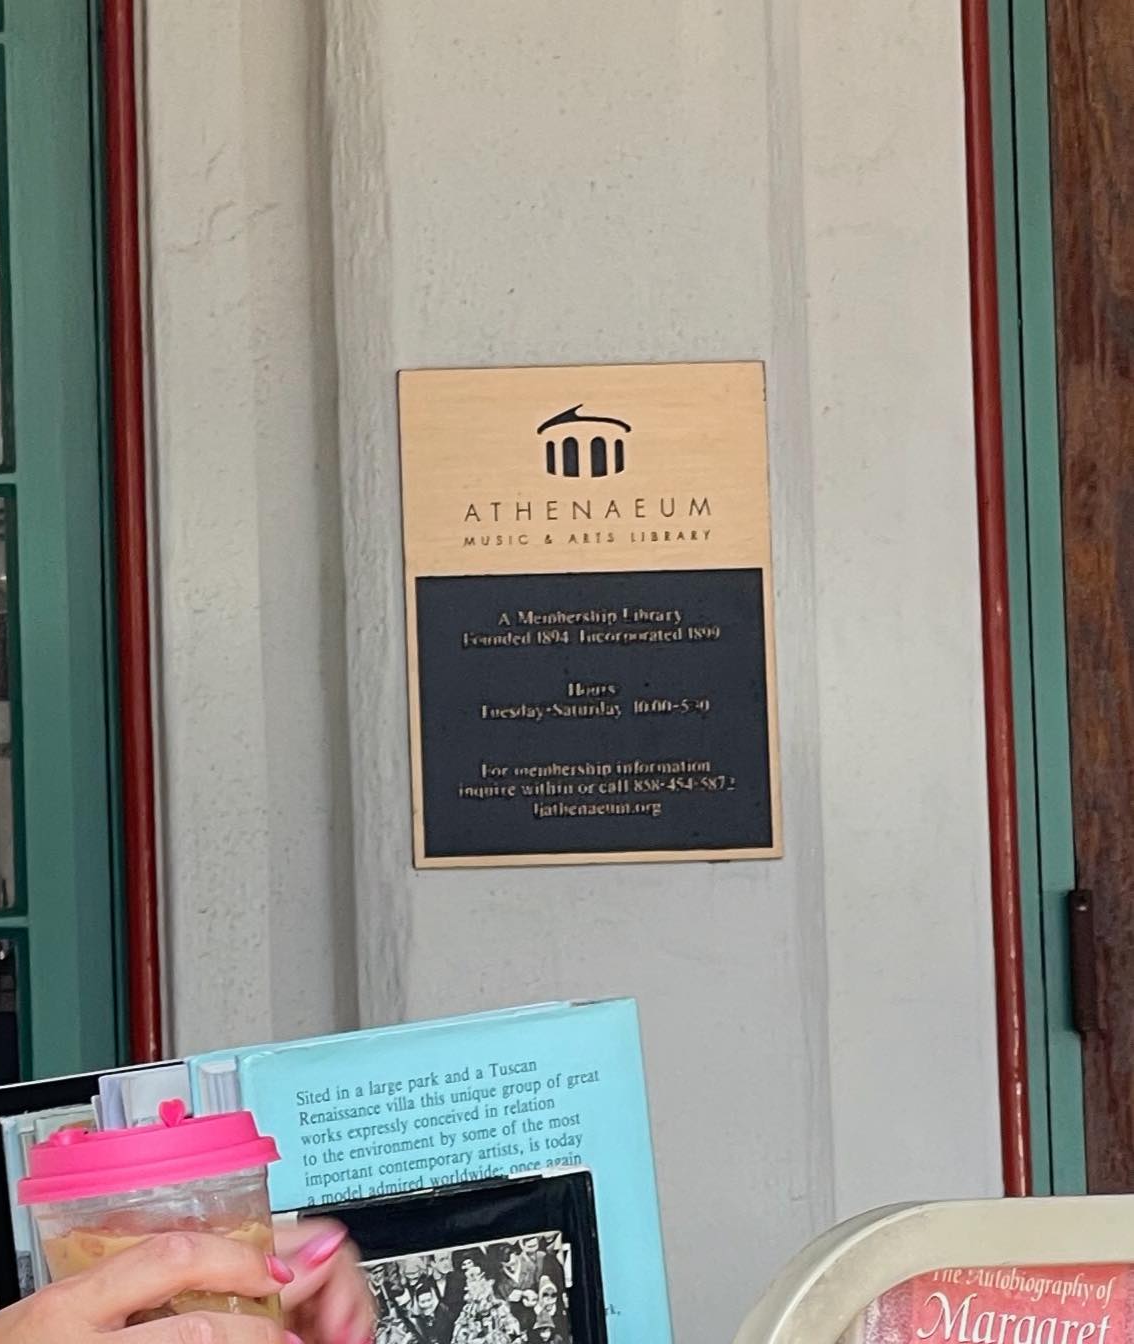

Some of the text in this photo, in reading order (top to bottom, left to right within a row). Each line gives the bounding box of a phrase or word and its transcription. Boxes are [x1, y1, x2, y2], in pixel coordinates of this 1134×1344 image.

[464, 496, 713, 523] ATHENAEUM
[463, 528, 712, 547] MUSIC & ARTS LIBRARY
[497, 606, 683, 627] A Membership Library
[462, 631, 532, 648] Founded
[579, 626, 684, 646] Incorporated
[567, 682, 616, 698] Hours
[481, 759, 711, 779] For membership information
[458, 781, 516, 800] inquire
[520, 781, 574, 797] within
[577, 782, 594, 795] or
[598, 777, 629, 794] call
[296, 1060, 538, 1106] Sited in a large park and a Tuscan
[298, 1068, 600, 1127] Renaissance villa this unique group of great
[300, 1096, 556, 1146] works expressly conceived in relation
[302, 1111, 582, 1168] to the environment by some of the most
[304, 1131, 584, 1188] important contemporary artists, is today
[306, 1194, 316, 1207] a
[321, 1185, 364, 1206] model
[368, 1175, 424, 1199] admired
[509, 1158, 541, 1175] once
[545, 1152, 583, 1169] again
[965, 1267, 1095, 1307] Autobiography
[1095, 1275, 1117, 1309] of
